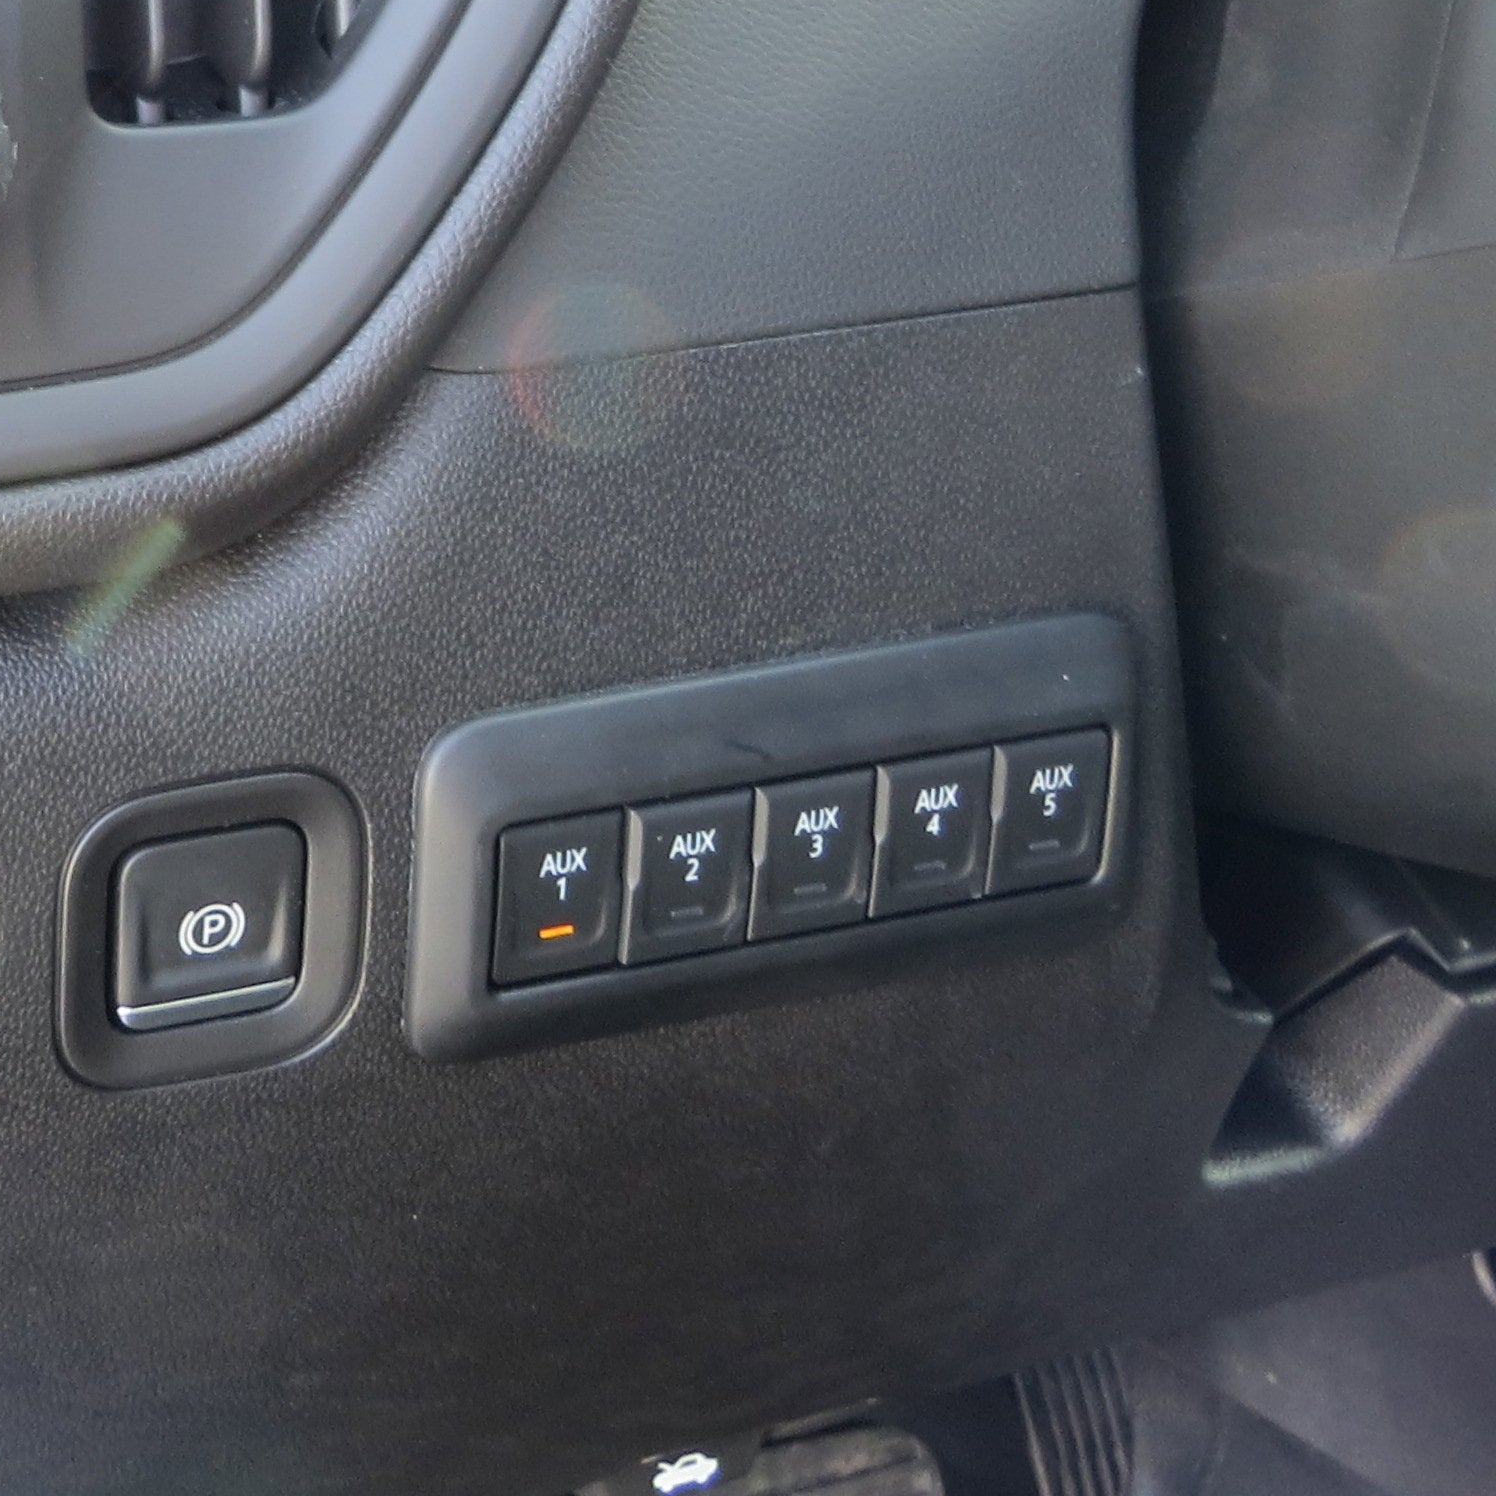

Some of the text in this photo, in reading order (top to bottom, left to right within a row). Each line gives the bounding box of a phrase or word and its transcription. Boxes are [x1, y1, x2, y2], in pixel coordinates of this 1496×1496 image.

[1029, 763, 1075, 794] AUX
[913, 783, 960, 814] AUX
[1042, 792, 1058, 817] 5
[793, 806, 841, 837] AUX
[925, 812, 942, 837] 4
[668, 828, 717, 859] AUX
[808, 834, 825, 858] 3
[538, 847, 588, 878] AUX
[684, 858, 701, 882] 2
[555, 877, 568, 901] 1
[202, 913, 226, 945] P
